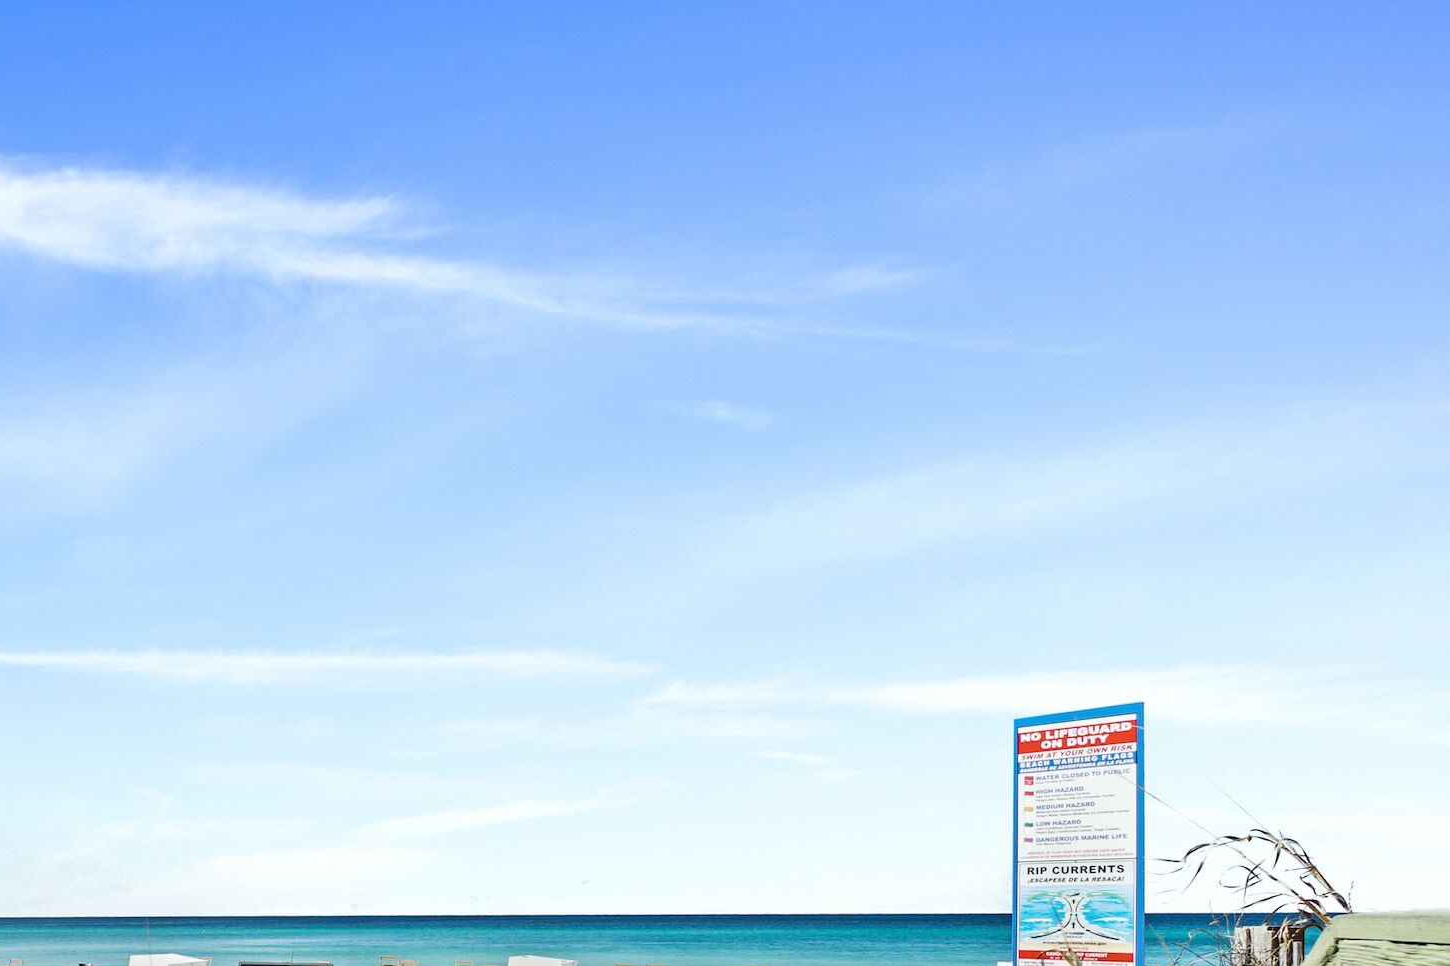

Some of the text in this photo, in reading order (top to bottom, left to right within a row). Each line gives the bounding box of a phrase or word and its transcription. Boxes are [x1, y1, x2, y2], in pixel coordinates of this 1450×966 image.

[1020, 722, 1132, 742] NO LIFEGUARD
[1041, 734, 1110, 749] ON DUTY
[1060, 749, 1084, 757] YOUR
[1020, 760, 1050, 768] BEACH
[1054, 756, 1097, 765] WARNING
[1104, 768, 1131, 776] PUBLIC
[1053, 865, 1125, 874] CURRENTS
